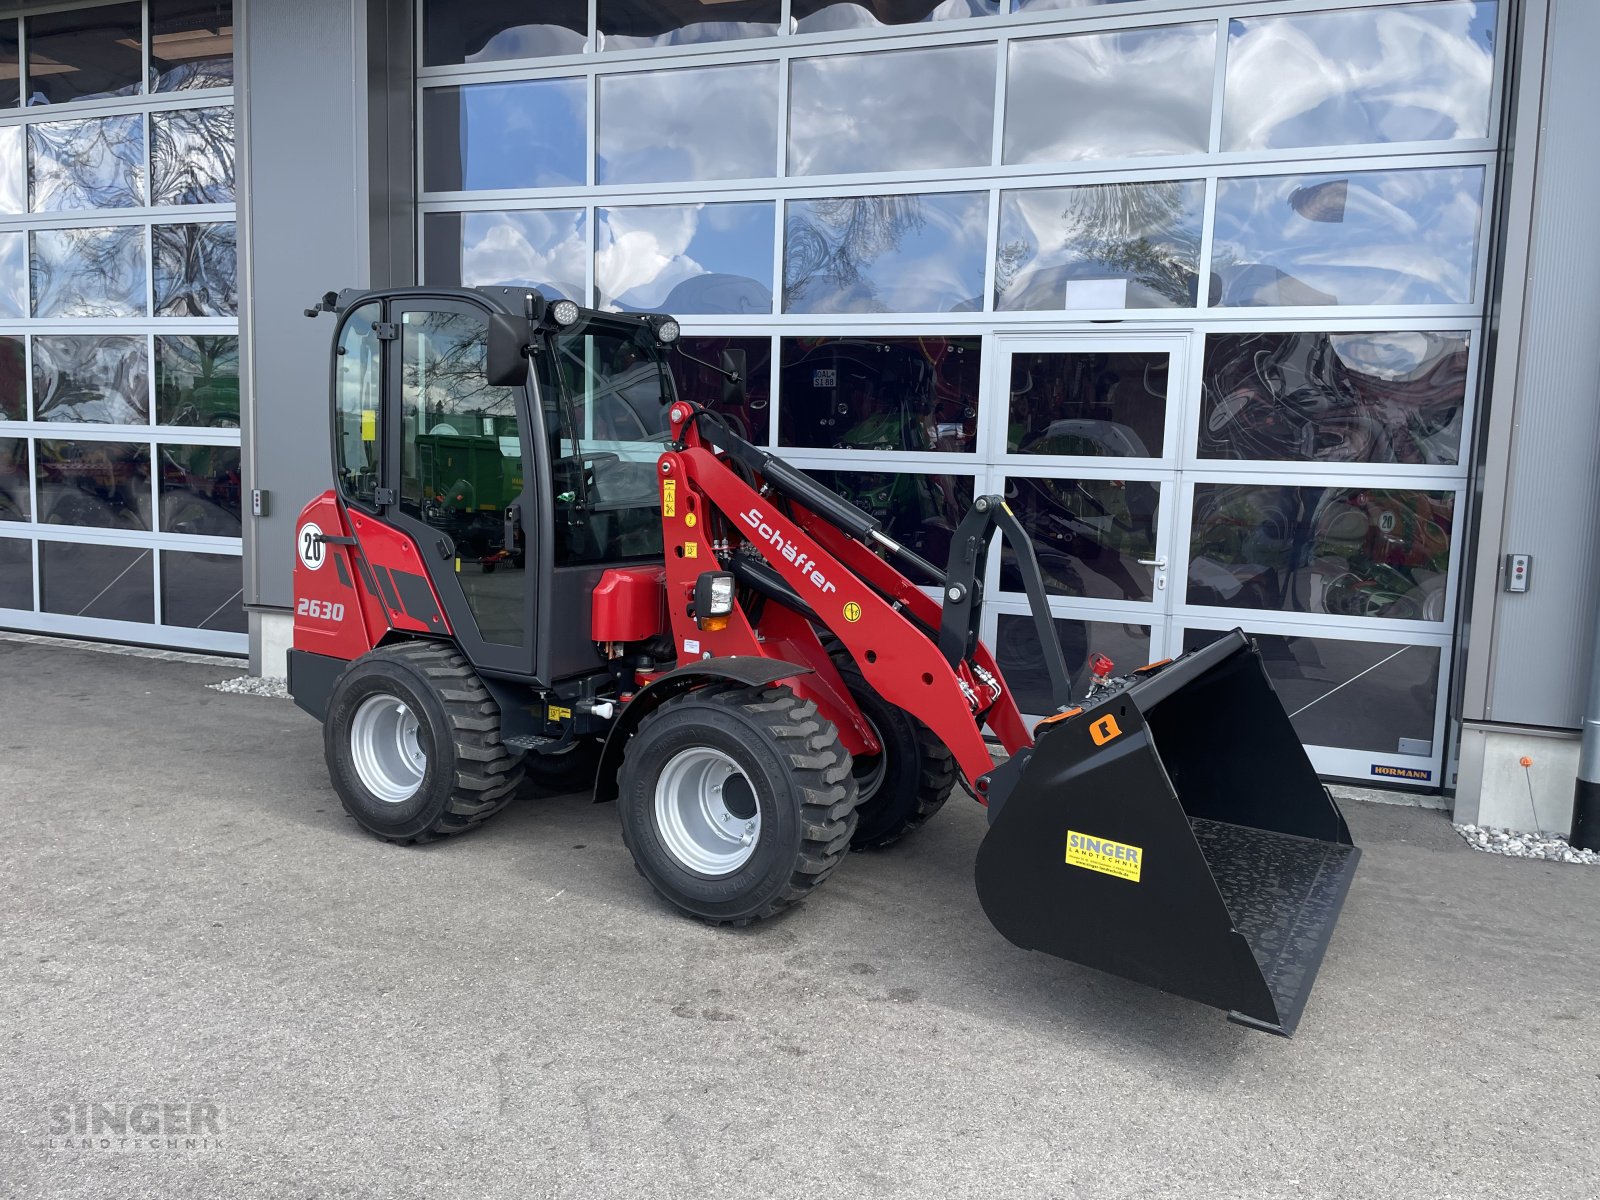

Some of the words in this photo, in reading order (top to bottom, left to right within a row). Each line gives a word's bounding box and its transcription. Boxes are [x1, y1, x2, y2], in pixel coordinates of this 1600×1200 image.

[1382, 515, 1393, 529] 20
[304, 532, 321, 561] 20
[740, 508, 836, 593] Schäffer
[297, 598, 345, 622] 2630
[1068, 847, 1139, 870] LANDTECHNIK
[1070, 834, 1139, 863] SINGER
